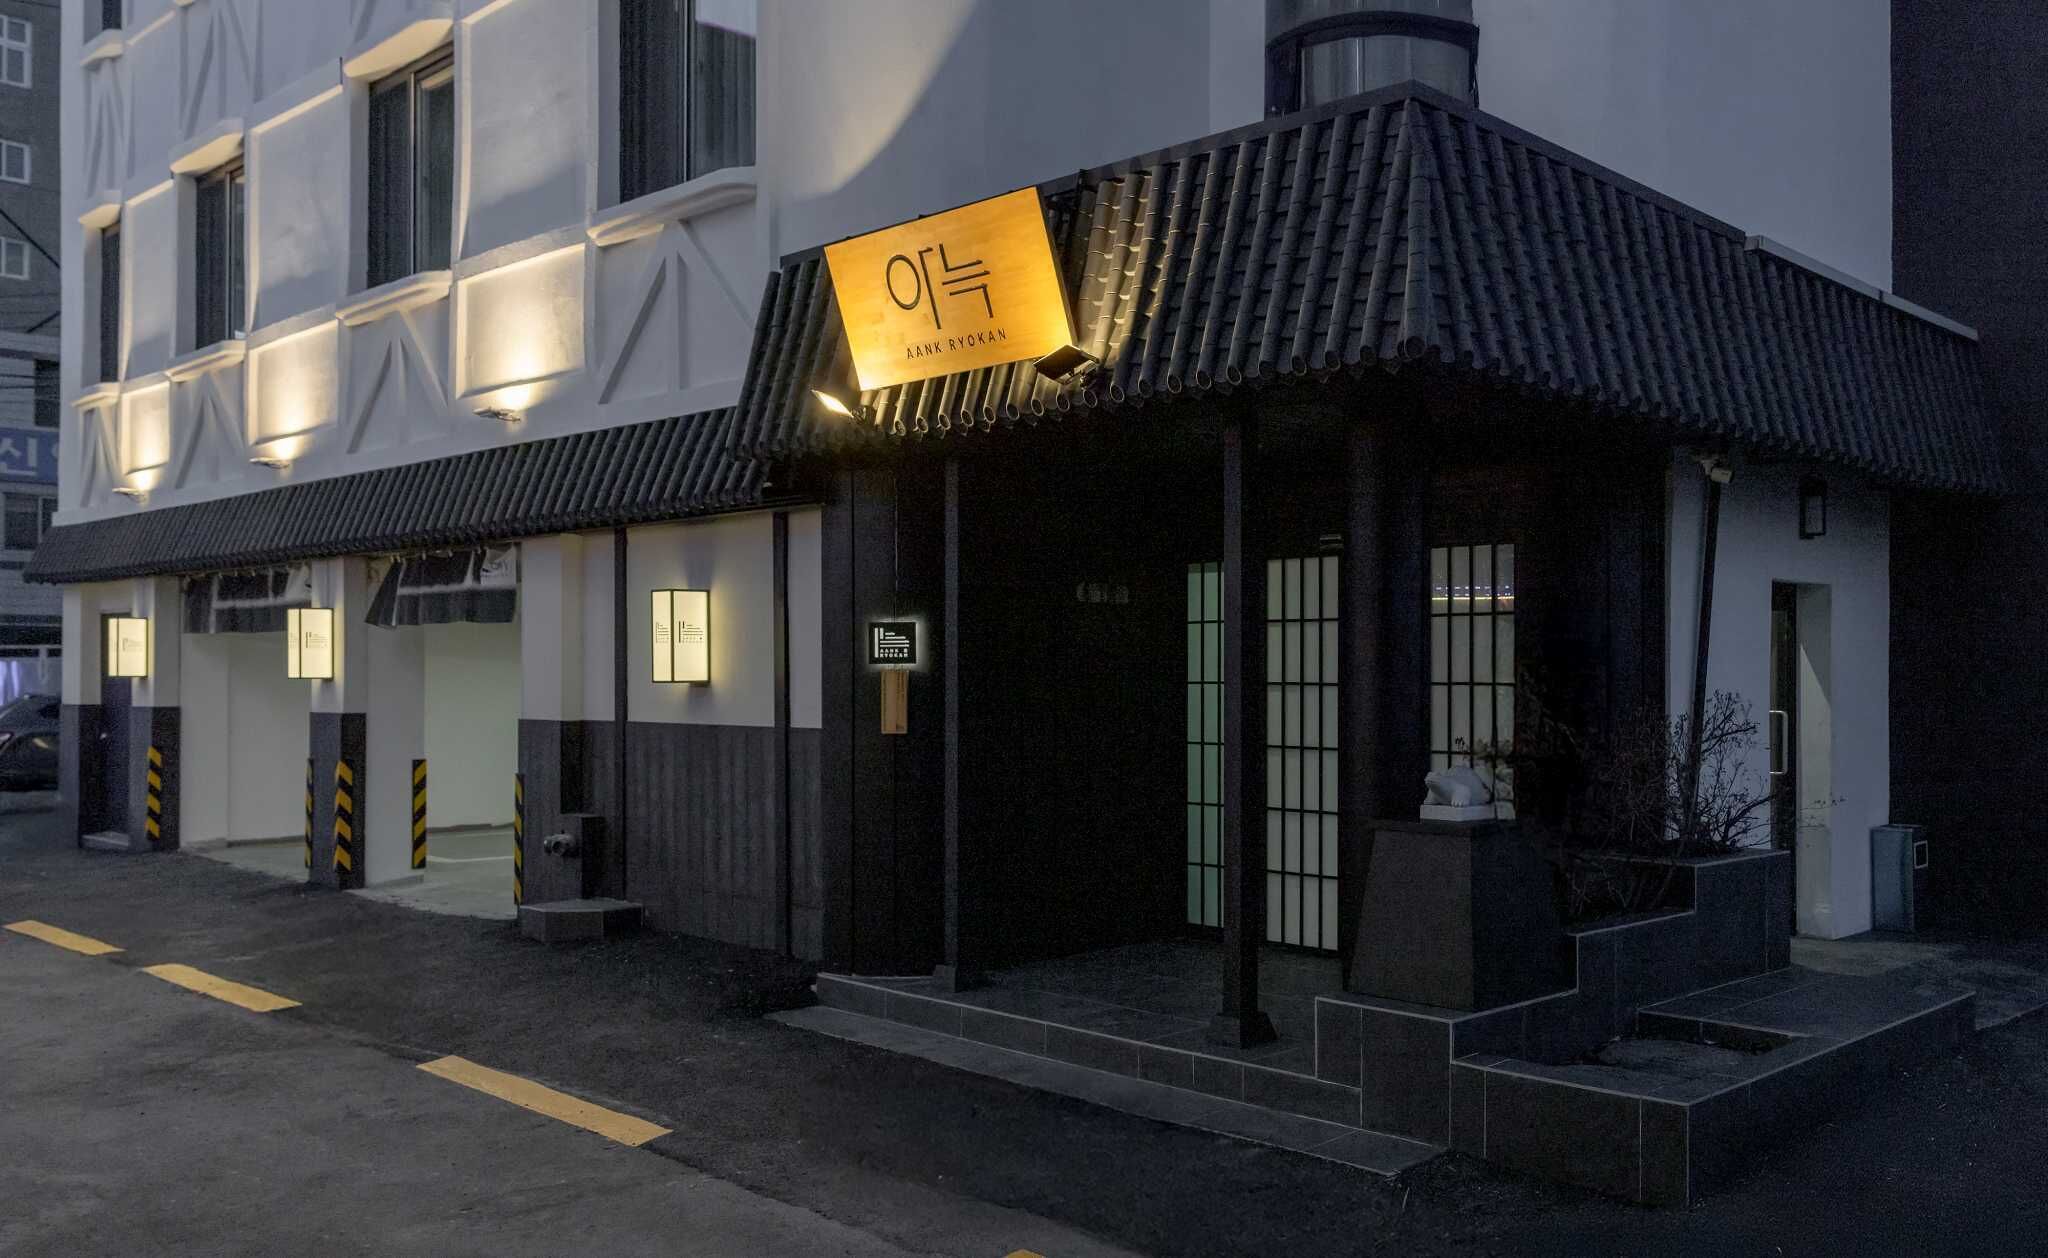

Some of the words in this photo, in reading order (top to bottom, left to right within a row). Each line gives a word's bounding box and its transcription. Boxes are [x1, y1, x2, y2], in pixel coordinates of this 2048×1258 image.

[886, 243, 992, 330] 아늑
[907, 342, 944, 360] AANK
[949, 329, 1007, 351] RYOKAN
